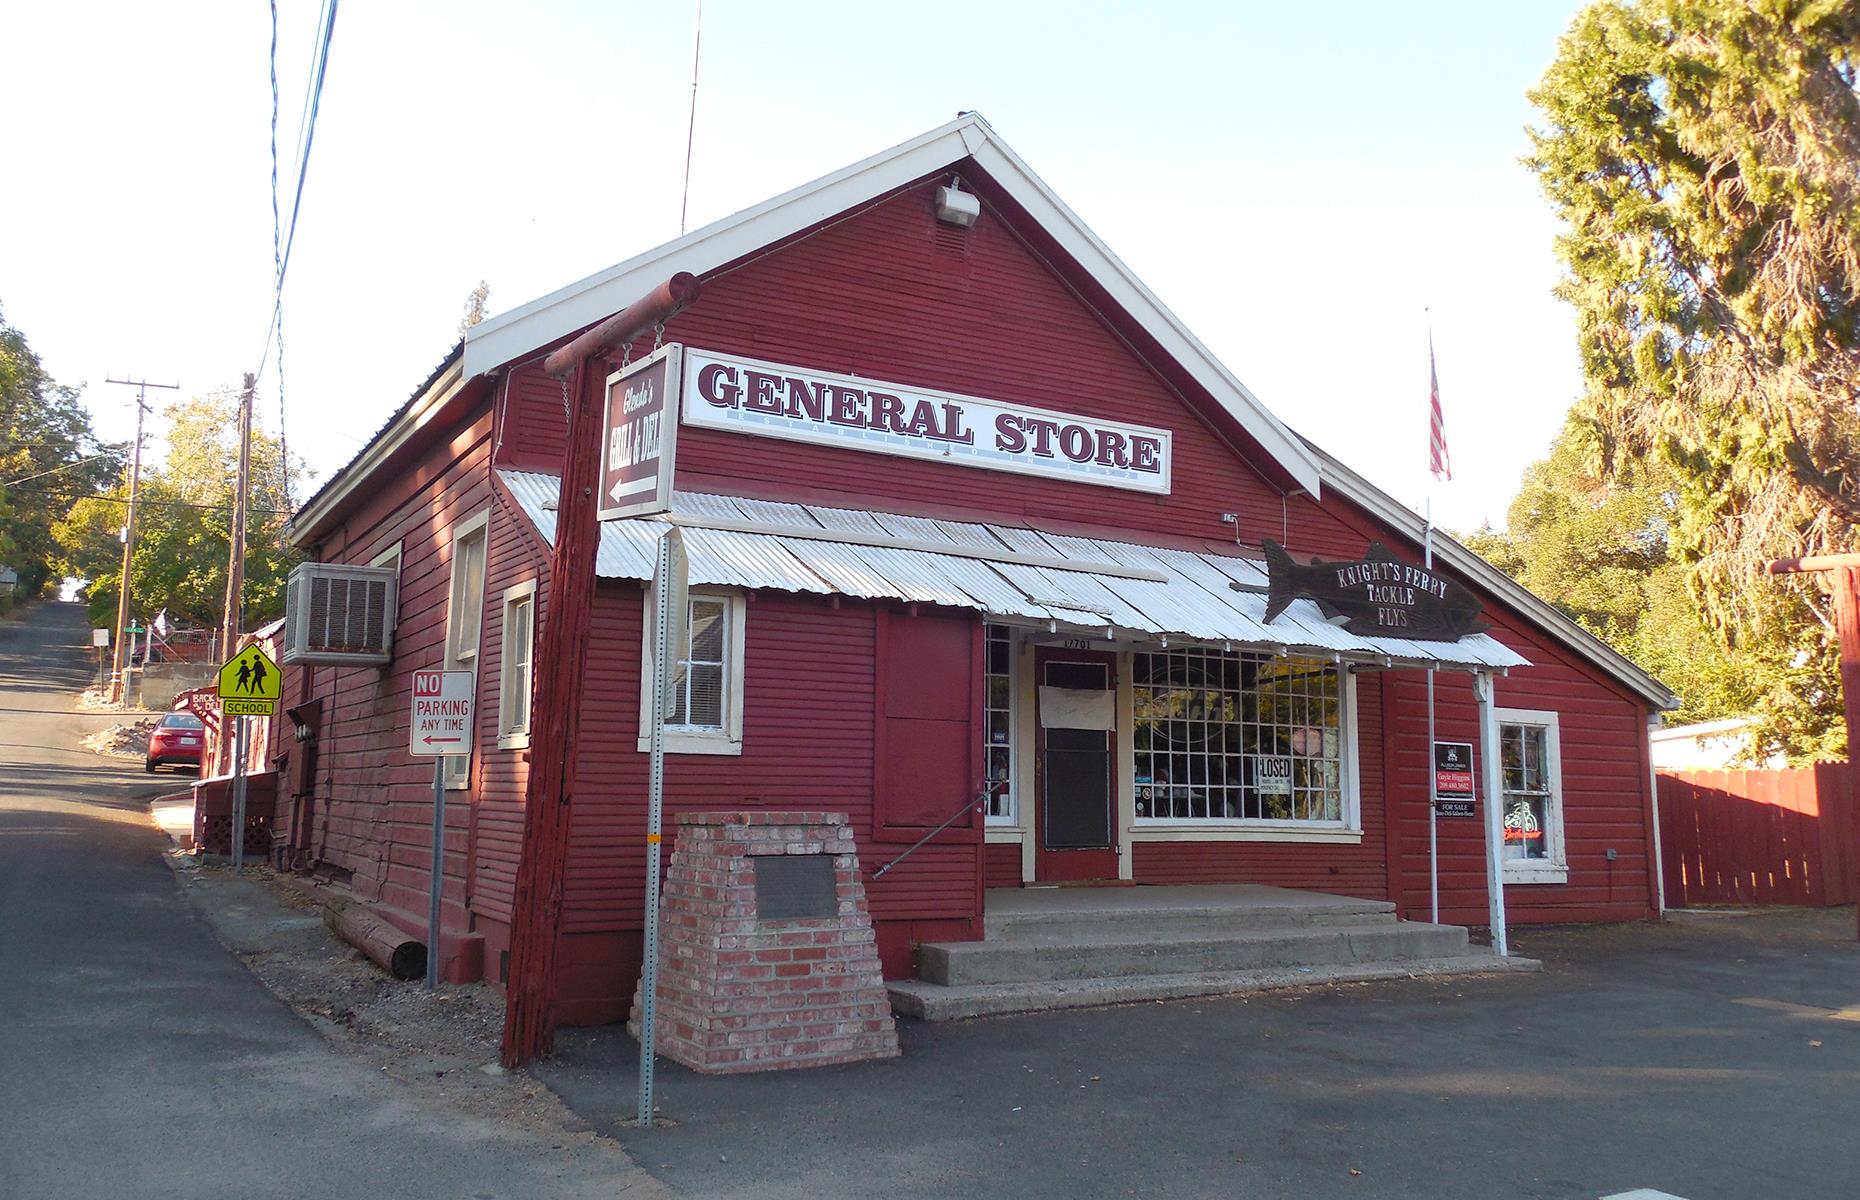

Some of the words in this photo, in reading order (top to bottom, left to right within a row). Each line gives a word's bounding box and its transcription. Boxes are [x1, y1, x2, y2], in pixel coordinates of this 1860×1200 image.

[623, 378, 654, 415] Glenda's
[697, 363, 974, 444] GENERAL
[995, 413, 1161, 474] STORE
[609, 422, 632, 472] GRILL
[633, 417, 640, 465] &
[737, 413, 978, 456] ESTABLISHED
[1008, 454, 1034, 465] IN
[1336, 562, 1400, 588] KNIGHT'S
[1405, 567, 1448, 599] FERRY
[1367, 584, 1415, 605] TACKLE
[1379, 607, 1408, 627] FLYS
[417, 675, 440, 693] NO
[227, 703, 270, 713] SCHOOL
[417, 700, 468, 716] PARKING
[421, 719, 440, 730] ANY
[444, 719, 464, 730] TIME
[1255, 758, 1290, 778] CLOSED
